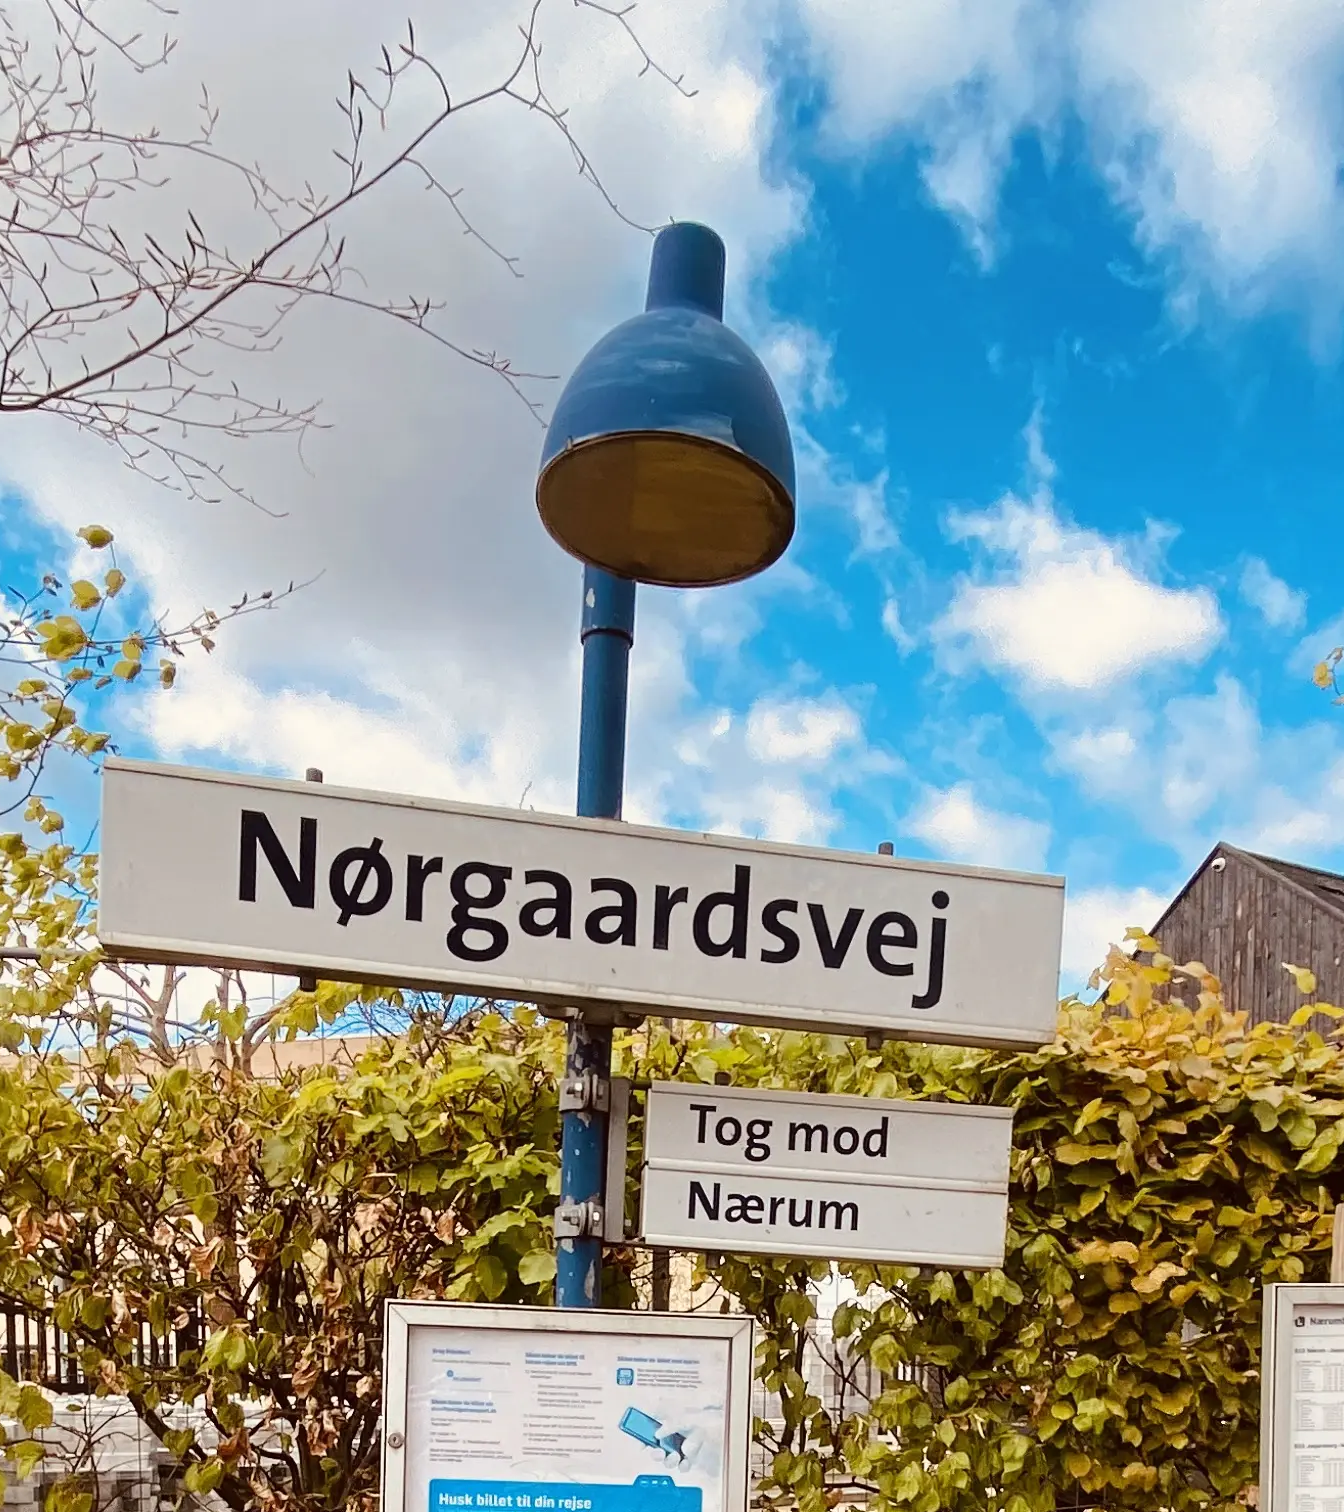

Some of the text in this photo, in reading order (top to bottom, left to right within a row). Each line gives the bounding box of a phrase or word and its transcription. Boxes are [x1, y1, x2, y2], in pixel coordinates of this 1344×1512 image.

[238, 808, 951, 1010] Nørgaardsvej
[689, 1104, 890, 1163] Tog mod
[687, 1180, 860, 1232] Nærum
[439, 1493, 592, 1511] Husk billet til din rejse
